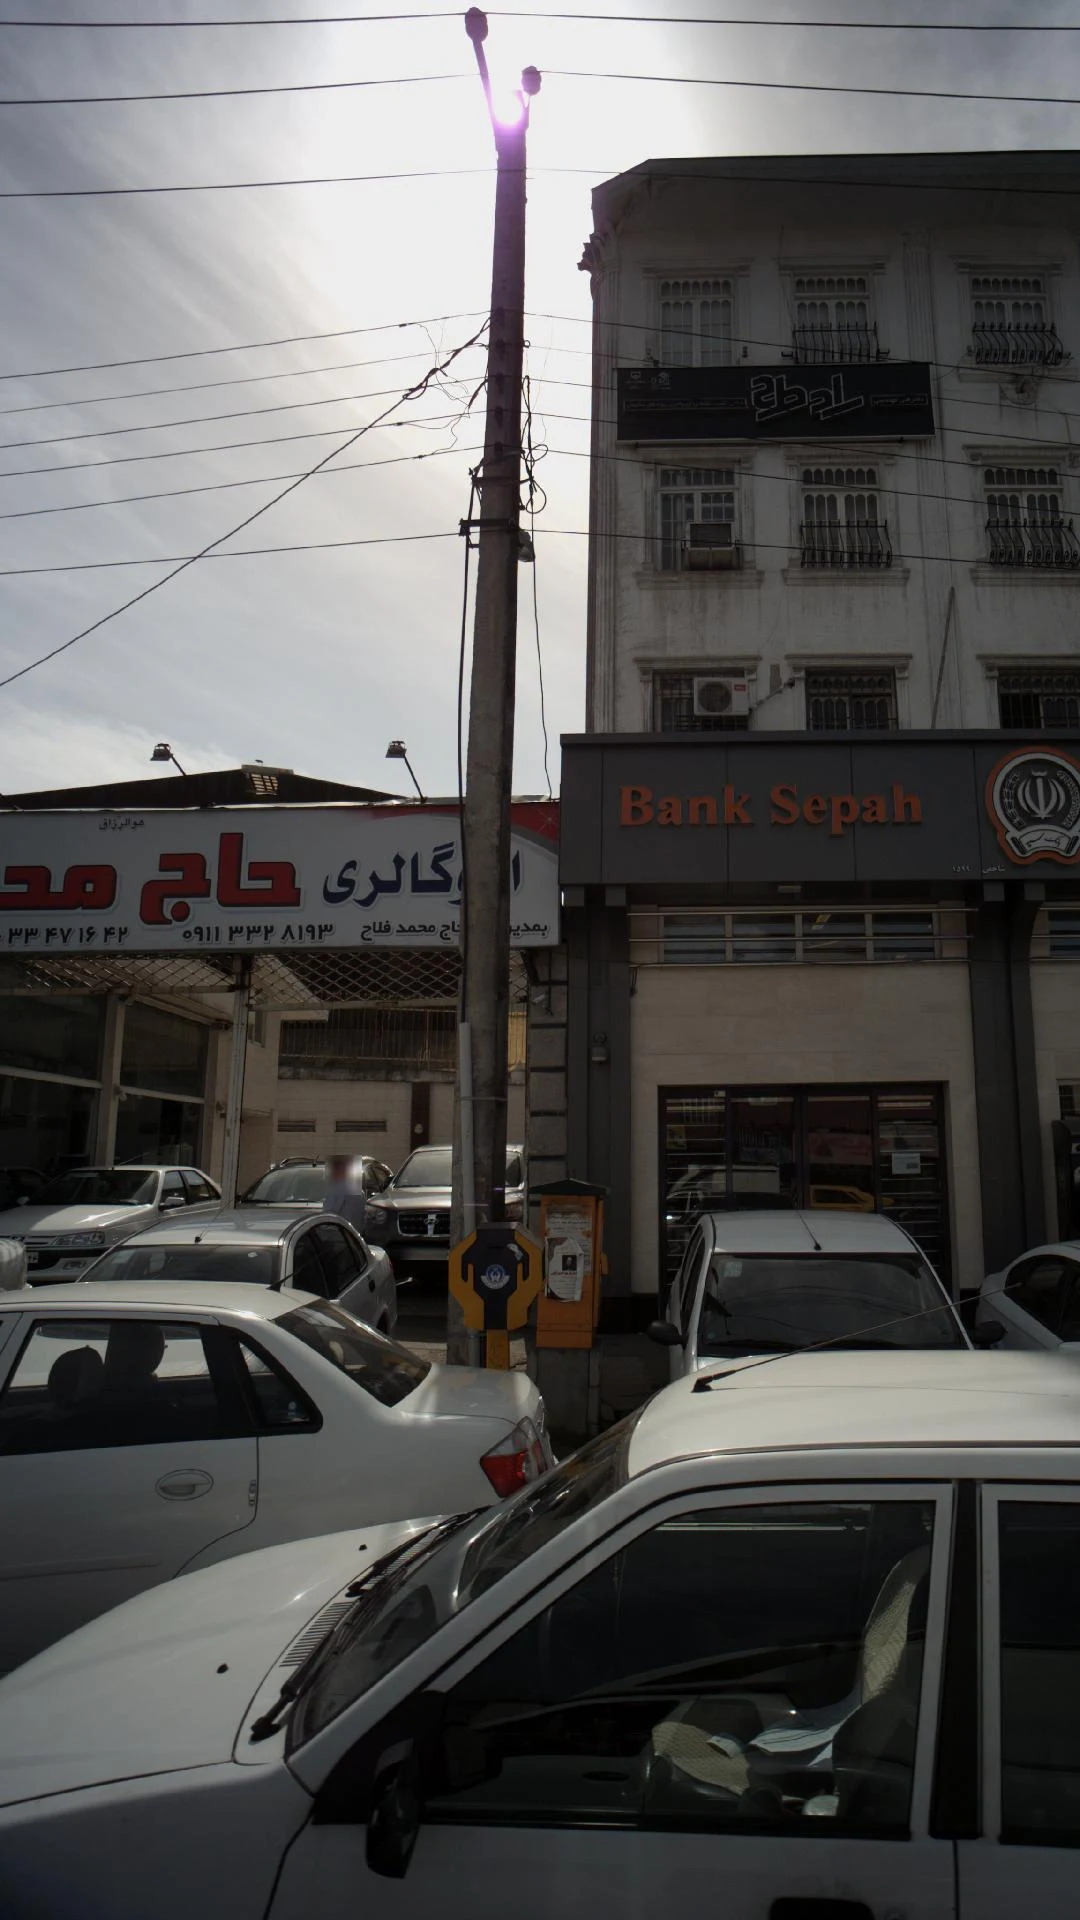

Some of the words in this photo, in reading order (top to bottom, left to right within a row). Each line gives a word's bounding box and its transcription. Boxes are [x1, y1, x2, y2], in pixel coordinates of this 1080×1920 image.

[620, 785, 753, 826] Bank
[770, 784, 922, 837] Sepah
[140, 832, 300, 925] حاج
[360, 920, 392, 942] فلاح
[396, 923, 436, 935] محمد
